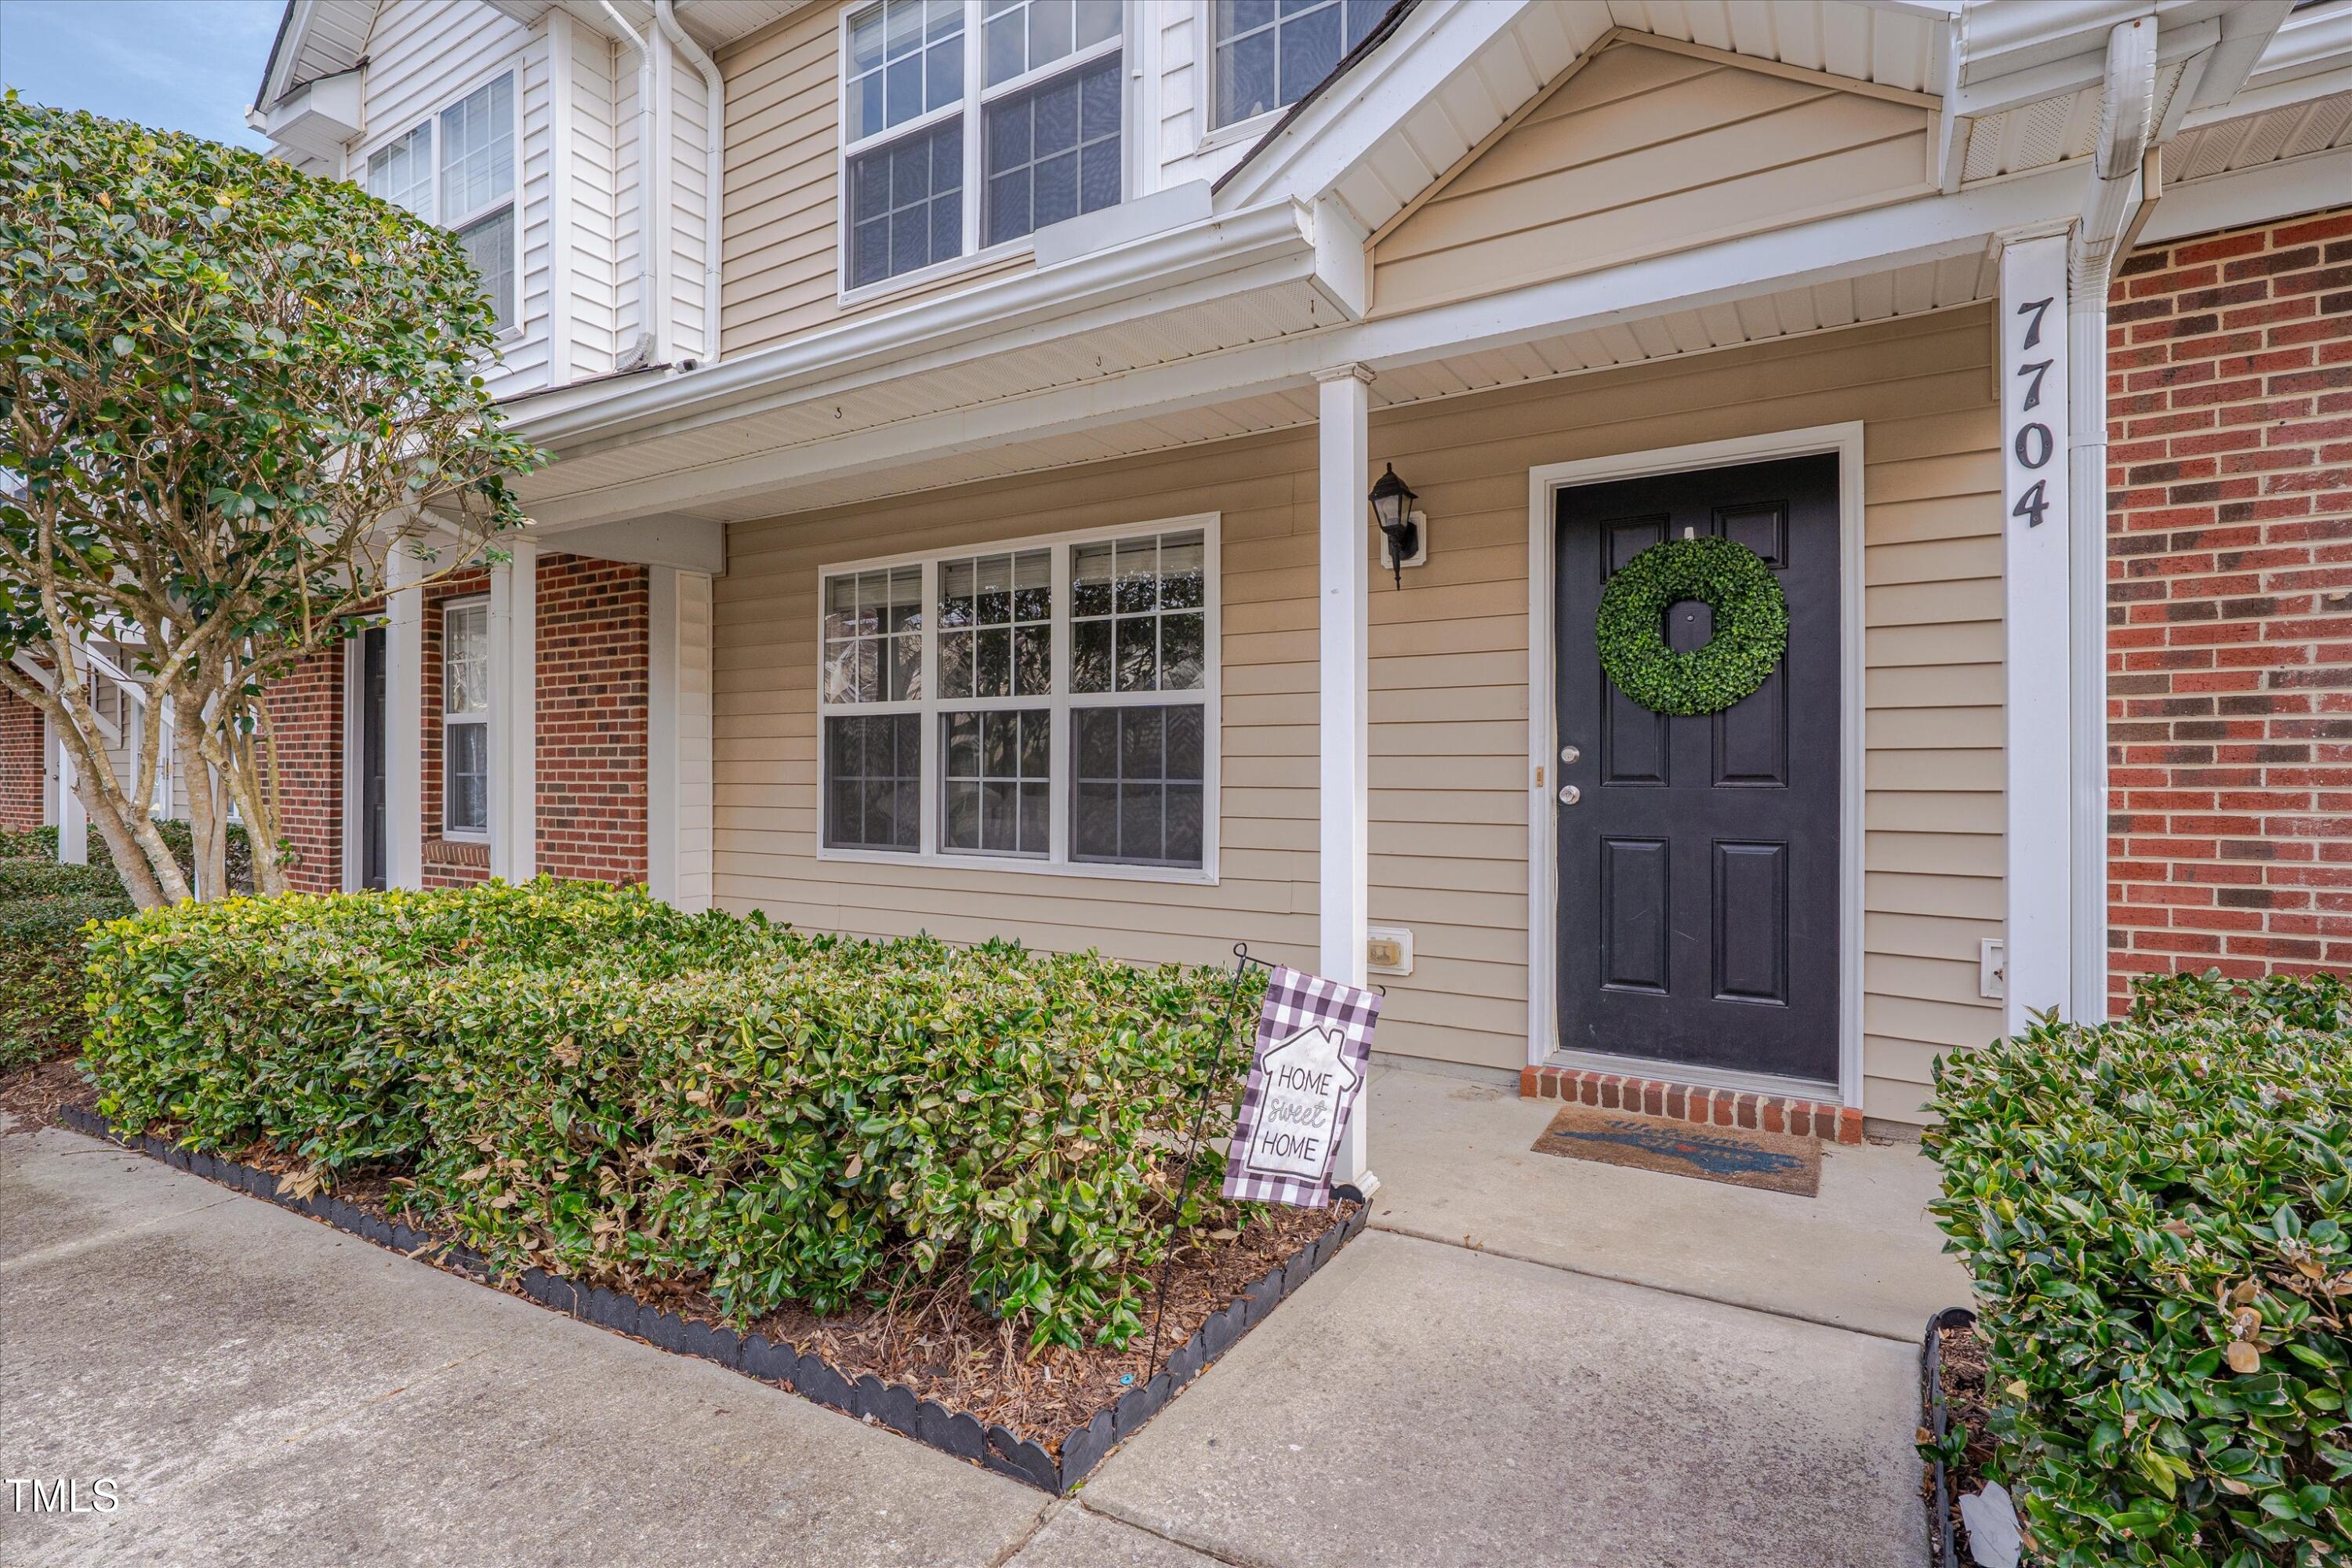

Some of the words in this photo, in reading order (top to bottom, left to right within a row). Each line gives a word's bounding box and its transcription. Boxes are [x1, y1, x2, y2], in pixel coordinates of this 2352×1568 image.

[2013, 296, 2054, 528] 7704
[1278, 1065, 1333, 1096] HOME
[1261, 1131, 1319, 1162] HOME
